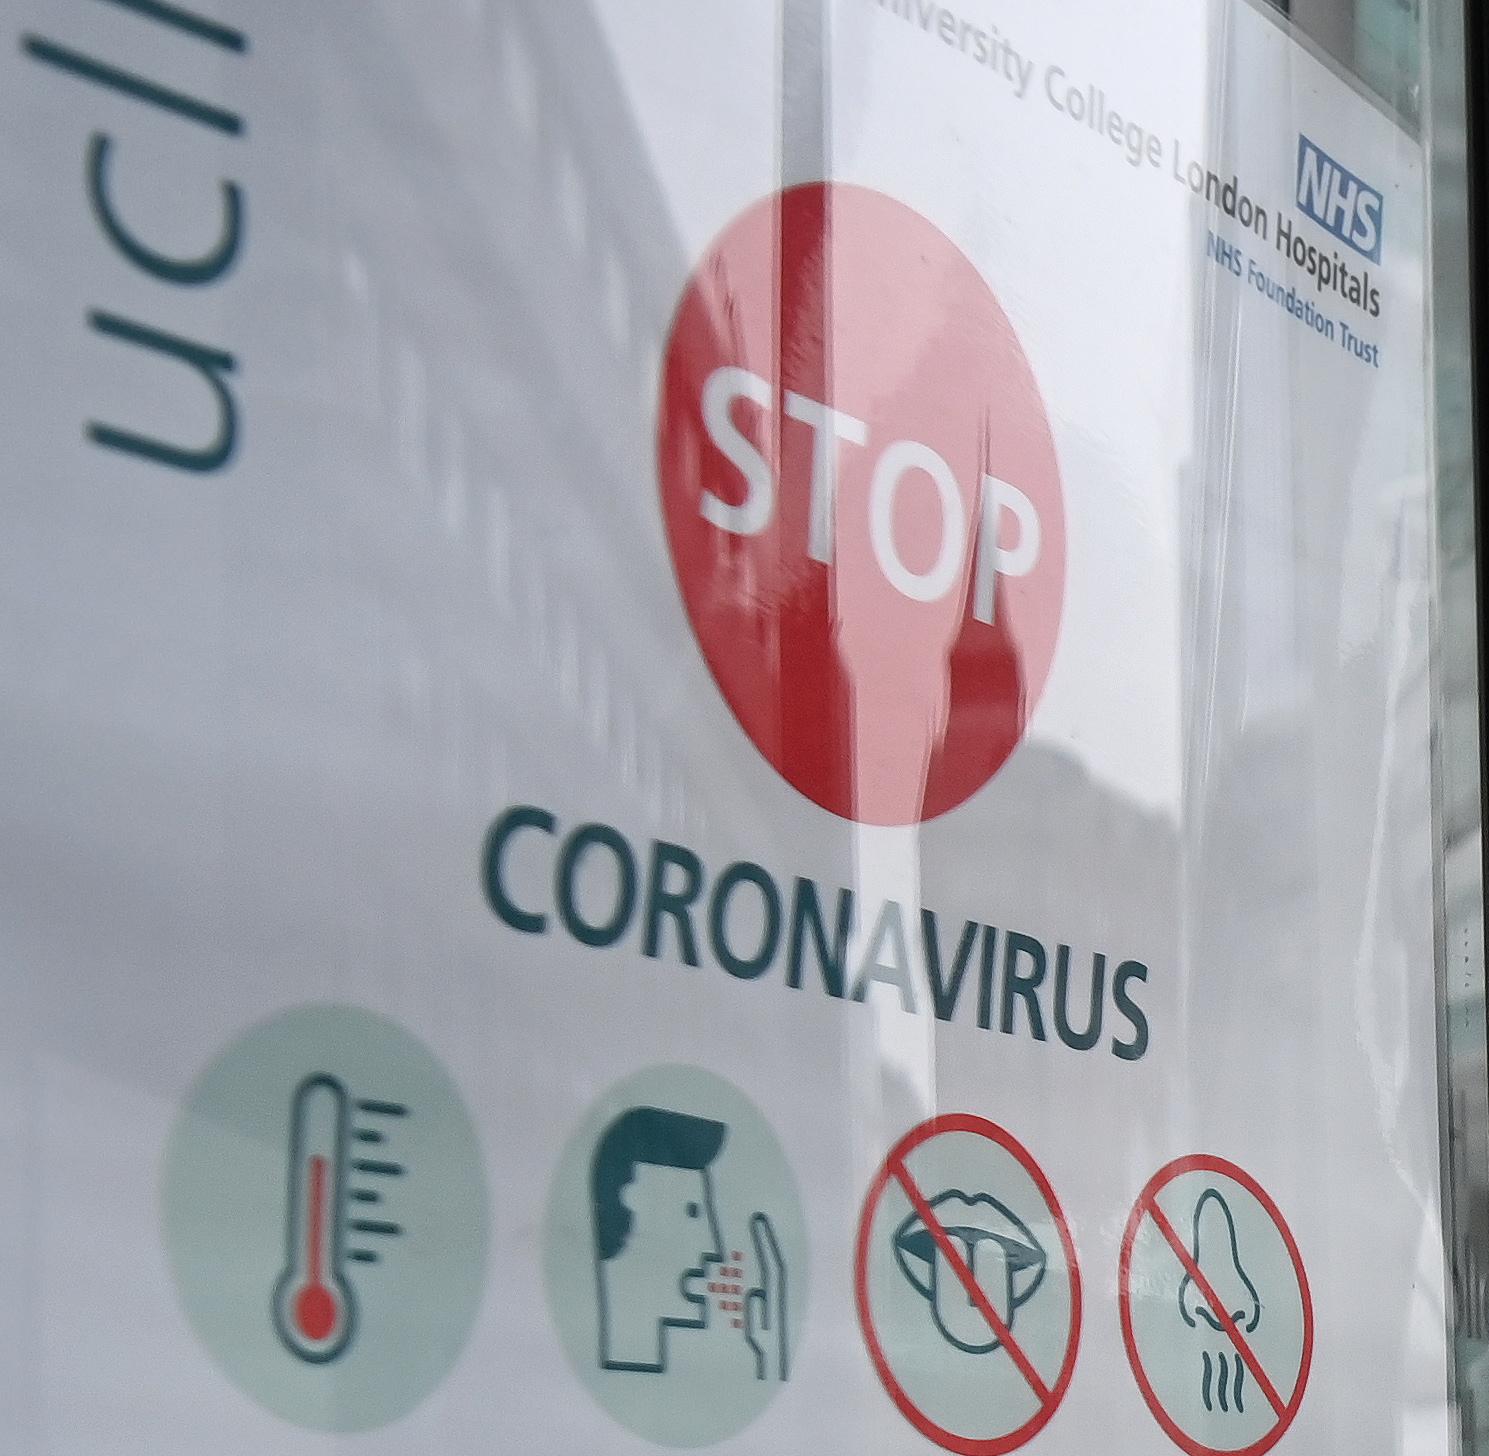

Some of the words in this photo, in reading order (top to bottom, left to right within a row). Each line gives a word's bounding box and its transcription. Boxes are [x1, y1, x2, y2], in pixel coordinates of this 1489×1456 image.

[1044, 65, 1161, 168] College
[1173, 138, 1268, 240] London
[1276, 211, 1381, 318] Hospitals
[1207, 230, 1242, 278] NHS
[1248, 258, 1334, 341] Foundation
[1339, 321, 1379, 368] Trust
[1298, 145, 1380, 252] NHS
[702, 366, 1042, 626] STOP
[479, 804, 1150, 1062] CORONAVIRUS
